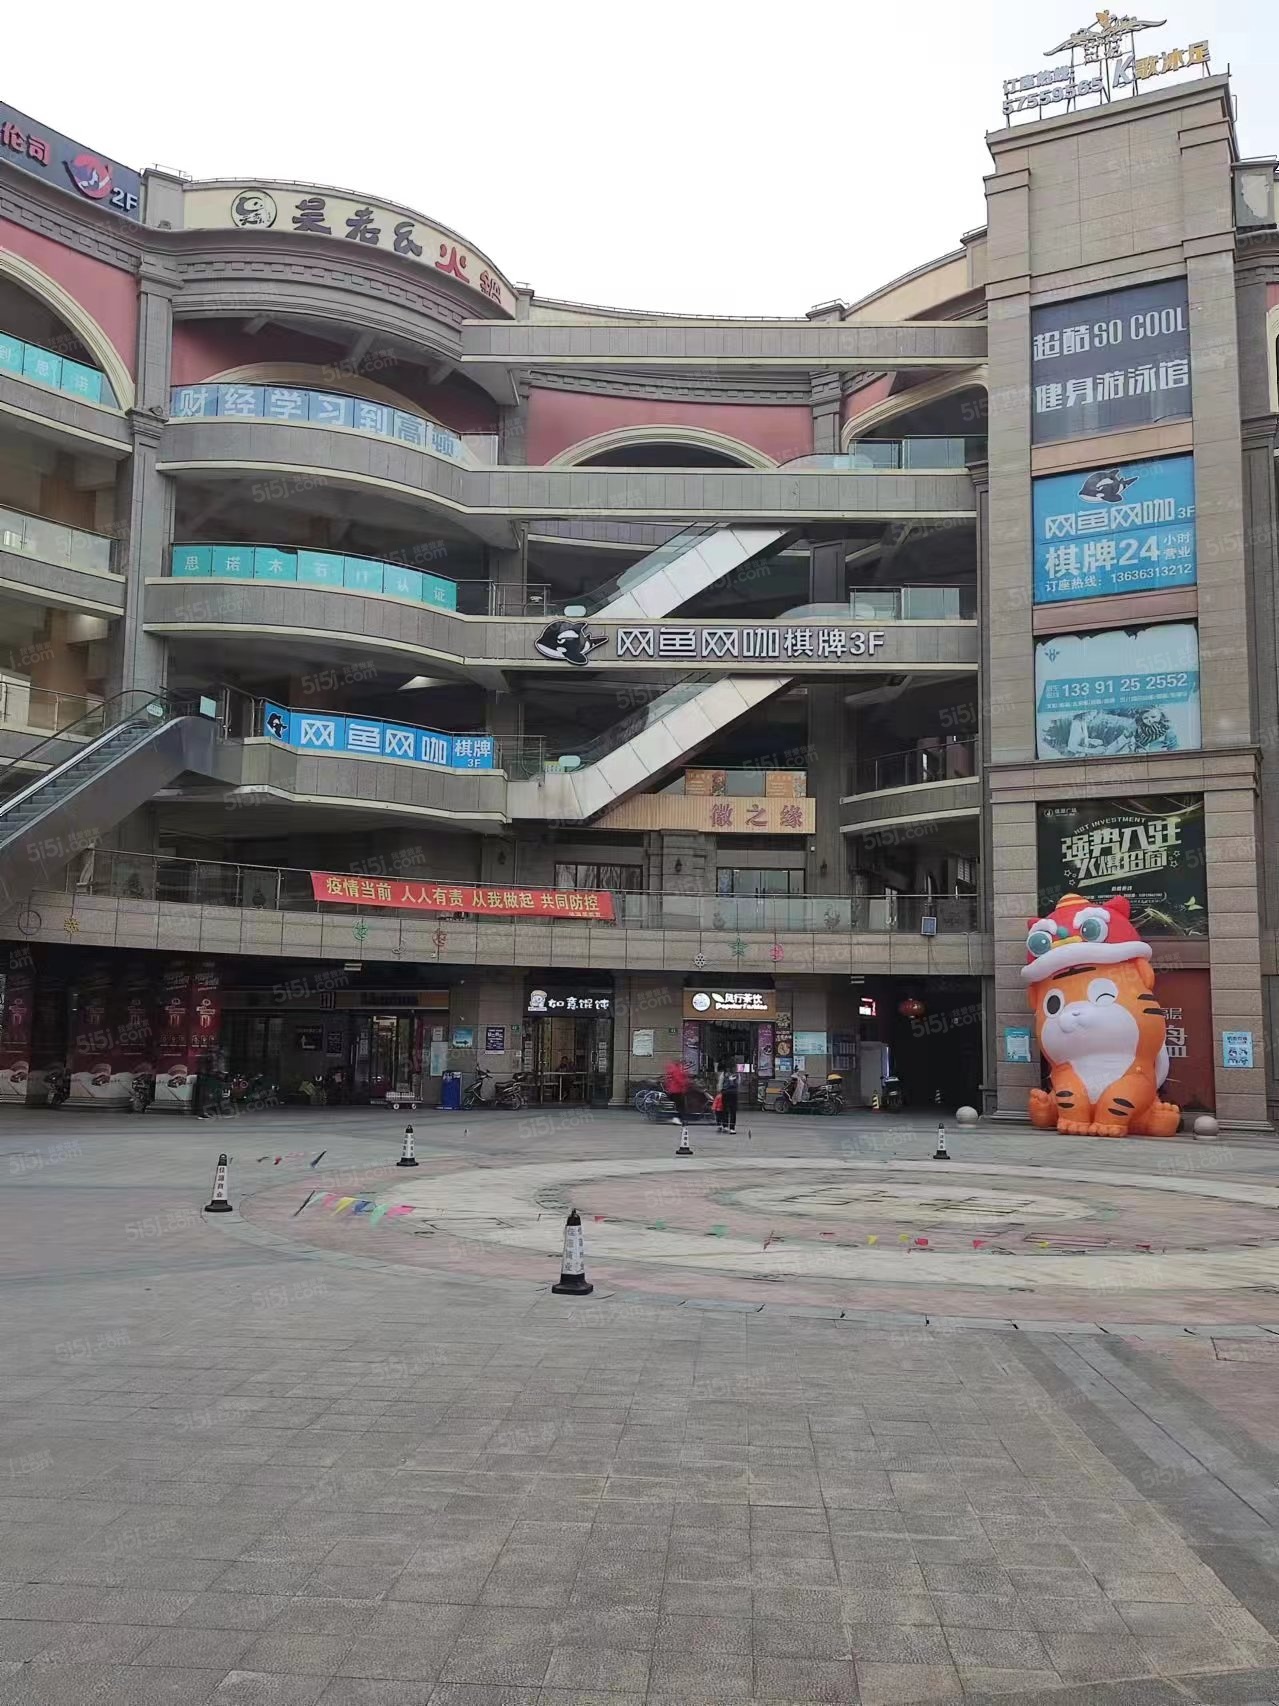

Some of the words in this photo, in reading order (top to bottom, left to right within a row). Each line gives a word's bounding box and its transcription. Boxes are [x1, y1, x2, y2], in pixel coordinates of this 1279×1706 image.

[112, 187, 138, 211] 2F
[1033, 324, 1090, 361] 超酷
[1094, 319, 1122, 349] SO
[1130, 306, 1187, 341] COOL
[1035, 358, 1190, 413] 健身游泳馆
[1045, 498, 1175, 538] 网鱼网咖
[1177, 505, 1195, 519] 3F
[1163, 531, 1190, 545] 小时
[1111, 563, 1192, 584] 13636313212
[1062, 683, 1089, 697] 133
[1095, 680, 1113, 694] 91
[1120, 678, 1140, 692] 25
[1146, 673, 1188, 690] 2552
[301, 719, 447, 765] 网鱼网咖
[454, 739, 491, 758] 棋牌
[467, 759, 481, 768] 3F
[1074, 825, 1089, 834] HOT
[1092, 817, 1146, 828] INVESTMENT
[1060, 816, 1182, 863] 强势入驻
[326, 877, 392, 901] 疫情当前
[401, 885, 464, 907] 人人有责
[472, 890, 535, 909] 从我做起
[541, 893, 600, 911] 共同防控
